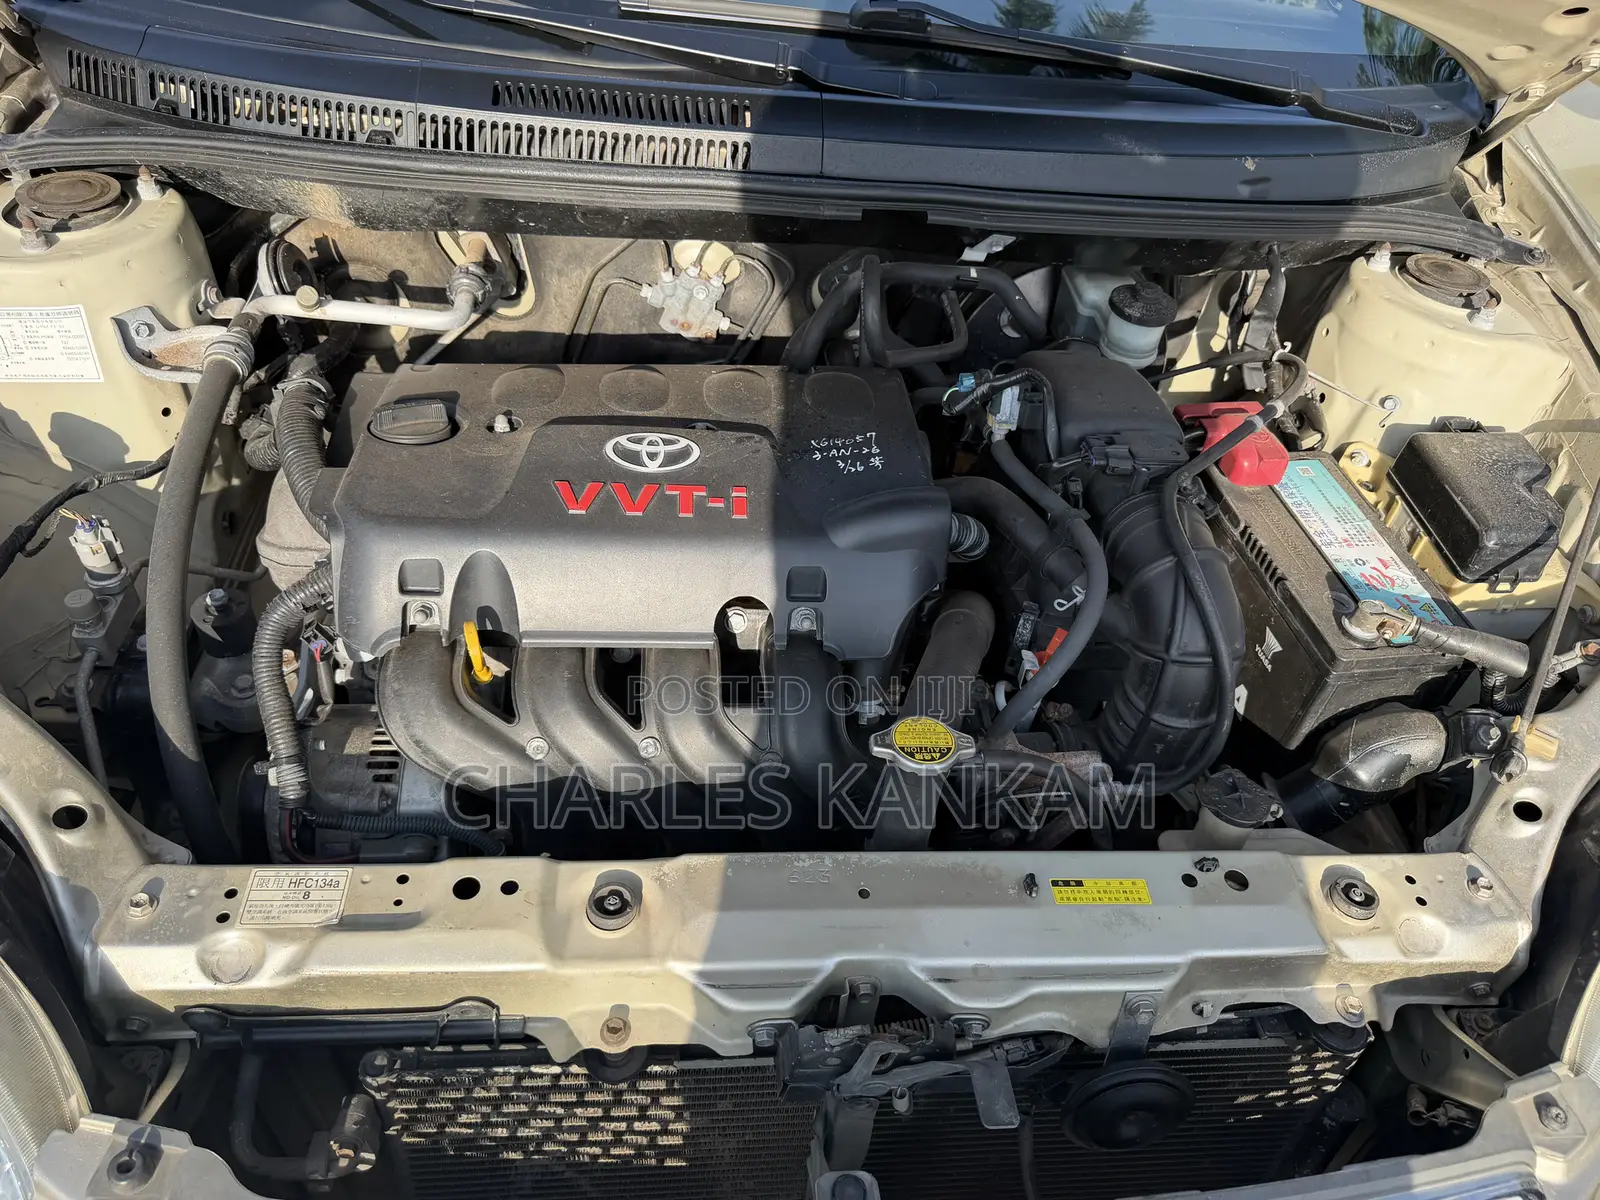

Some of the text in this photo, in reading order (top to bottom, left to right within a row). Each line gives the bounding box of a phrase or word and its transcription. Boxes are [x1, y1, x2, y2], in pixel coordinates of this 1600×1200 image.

[552, 480, 748, 519] VVT-i
[255, 877, 340, 888] 限用 HFC134a
[302, 891, 311, 900] 8
